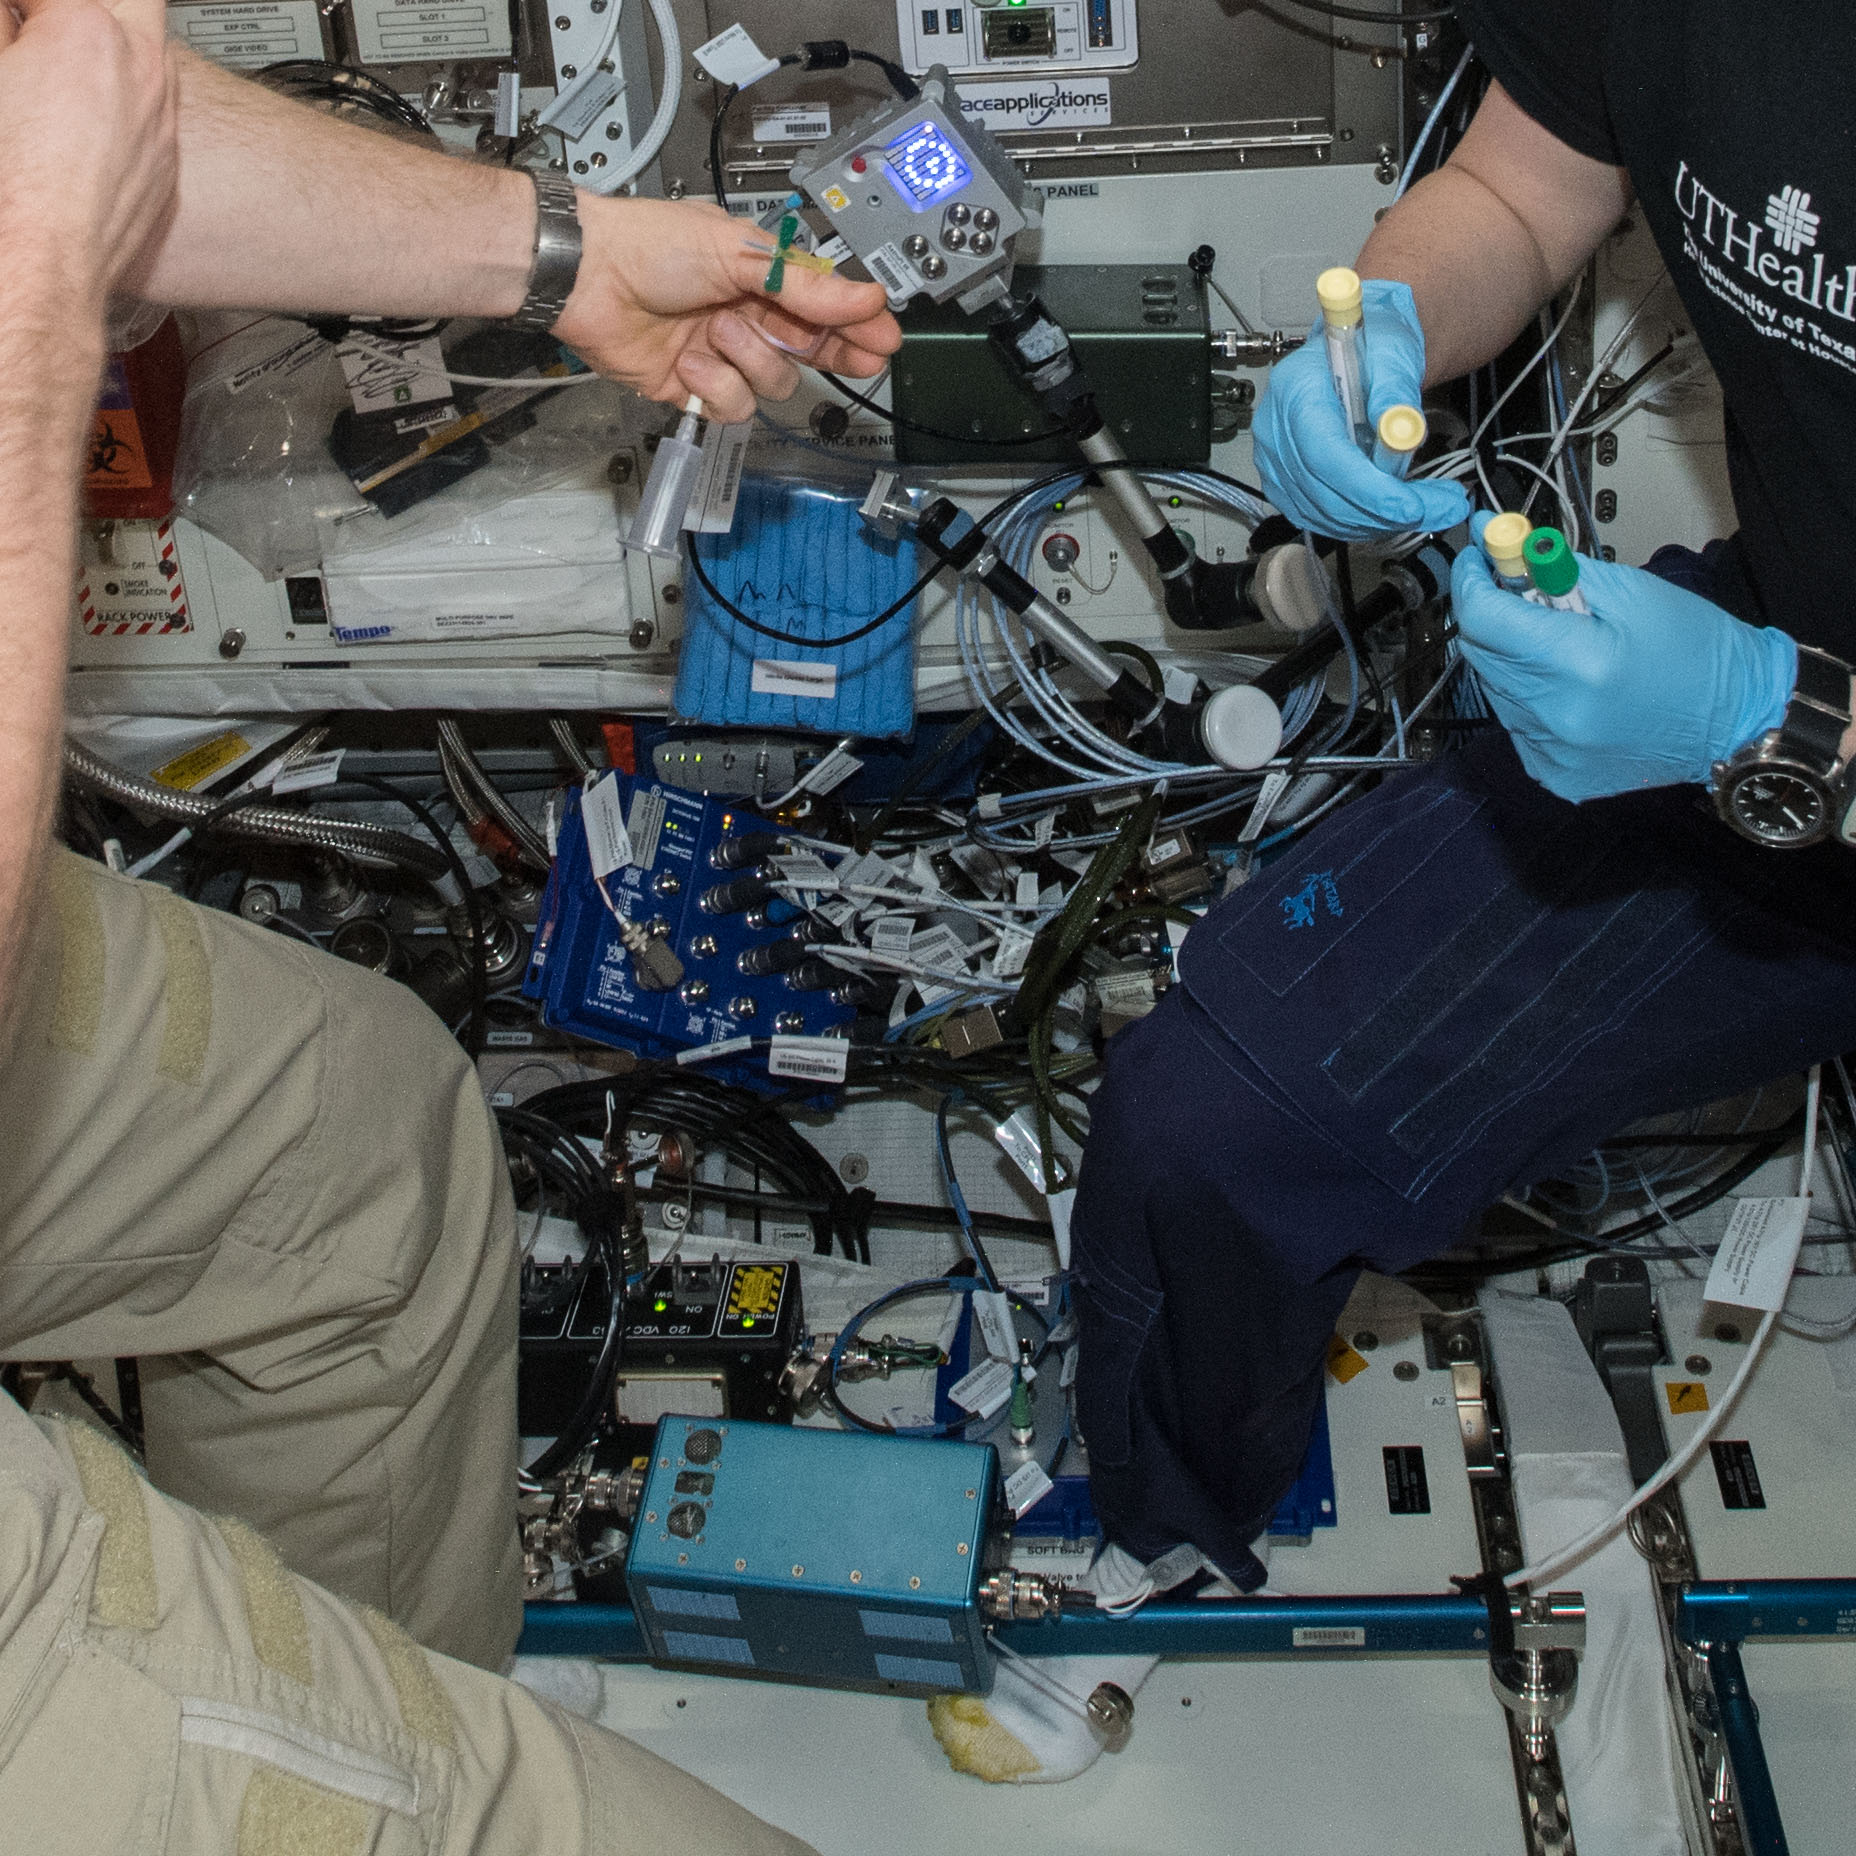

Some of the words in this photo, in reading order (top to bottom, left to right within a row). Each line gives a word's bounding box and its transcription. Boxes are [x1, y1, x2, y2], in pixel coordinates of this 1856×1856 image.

[200, 7, 229, 17] SYSTEM
[232, 6, 254, 15] HARD
[256, 5, 279, 14] DRIVE
[419, 13, 437, 22] SLOT
[423, 35, 440, 43] SLOT
[1047, 183, 1099, 200] PANEL
[1698, 251, 1778, 323] University
[1782, 314, 1805, 334] of
[97, 611, 125, 624] RACK
[129, 610, 172, 624] POWER
[336, 623, 391, 642] Tempo
[633, 1324, 660, 1335] VDC
[1027, 1546, 1058, 1556] SOFT
